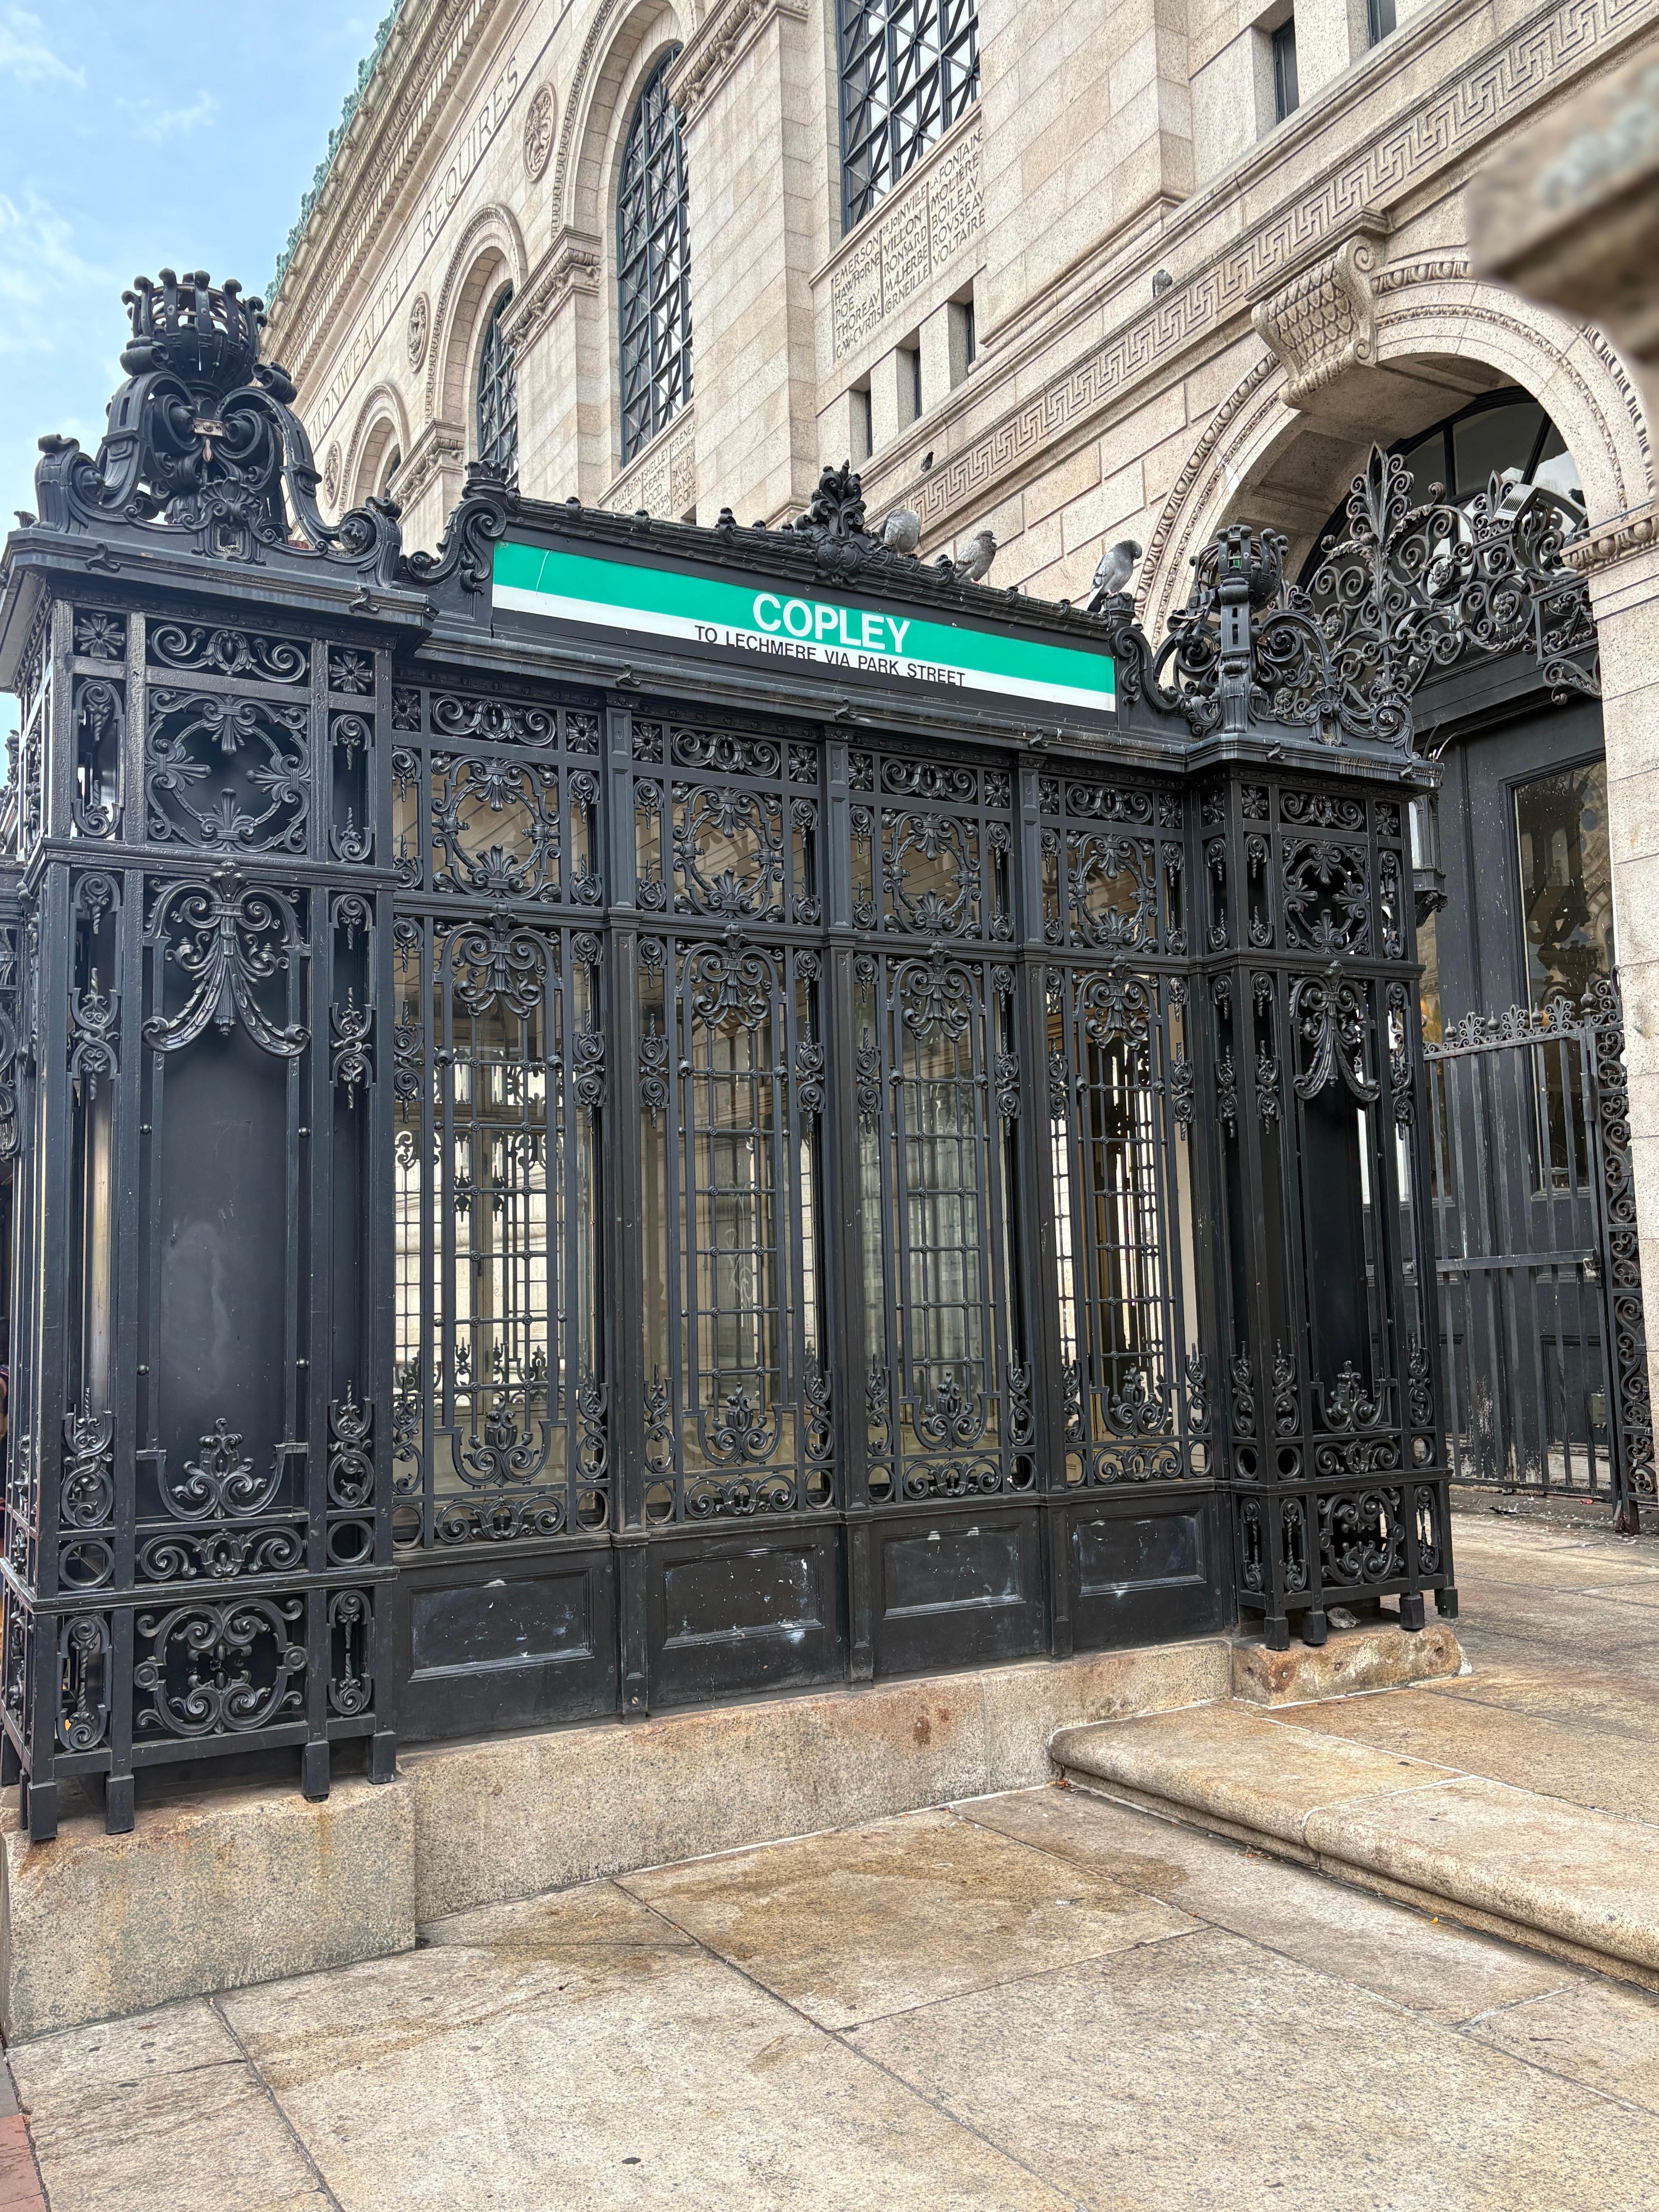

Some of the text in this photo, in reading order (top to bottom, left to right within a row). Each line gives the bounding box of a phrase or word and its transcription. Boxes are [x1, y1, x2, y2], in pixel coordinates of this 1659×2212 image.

[930, 126, 983, 190] LA FONTAINE
[882, 184, 926, 235] DE JOINVILLE
[883, 209, 922, 256] VILLON
[309, 56, 518, 450] MONWEALTH REQUIRES
[835, 232, 879, 288] EMERSON
[884, 225, 927, 278] RONSARD
[933, 208, 986, 270] VOLTAIRE
[835, 251, 880, 306] HAWTHORNE
[884, 244, 928, 297] MALHERBE
[836, 296, 855, 324] POE
[643, 447, 668, 481] SHELLEY
[643, 466, 665, 493] KEATS
[644, 484, 662, 509] HOOD
[753, 593, 911, 653] COPLEY
[694, 625, 965, 687] TO LECHMERE VIA PARK STREET
